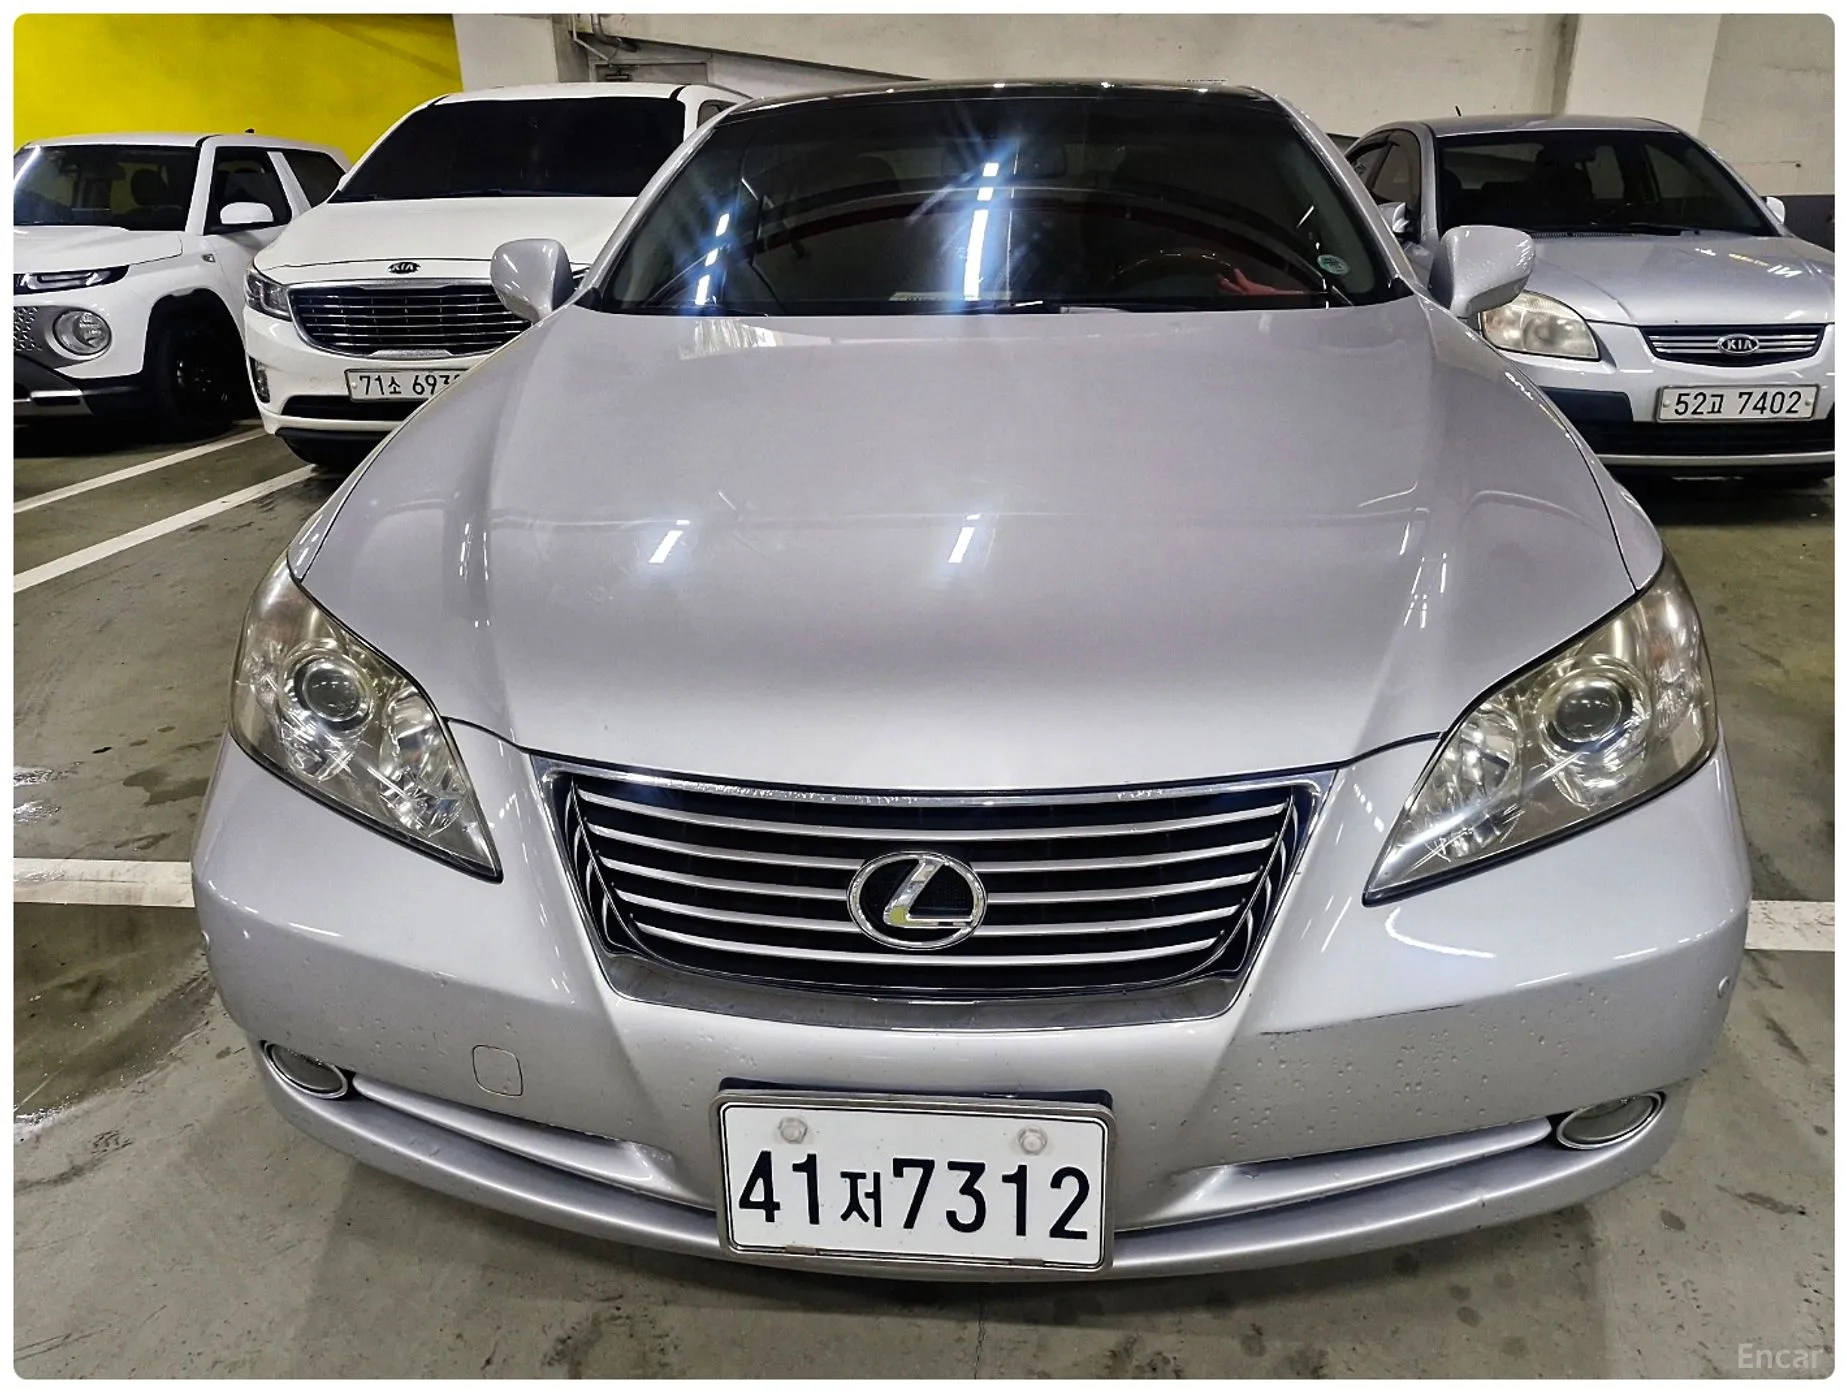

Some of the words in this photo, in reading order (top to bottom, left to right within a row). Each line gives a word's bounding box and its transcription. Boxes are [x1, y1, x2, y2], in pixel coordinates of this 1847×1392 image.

[391, 263, 414, 271] KIA
[1726, 339, 1754, 350] KIA
[359, 374, 402, 396] 71소
[1674, 391, 1724, 416] 52고
[1738, 391, 1802, 415] 7402
[738, 1150, 1091, 1240] 41저7312
